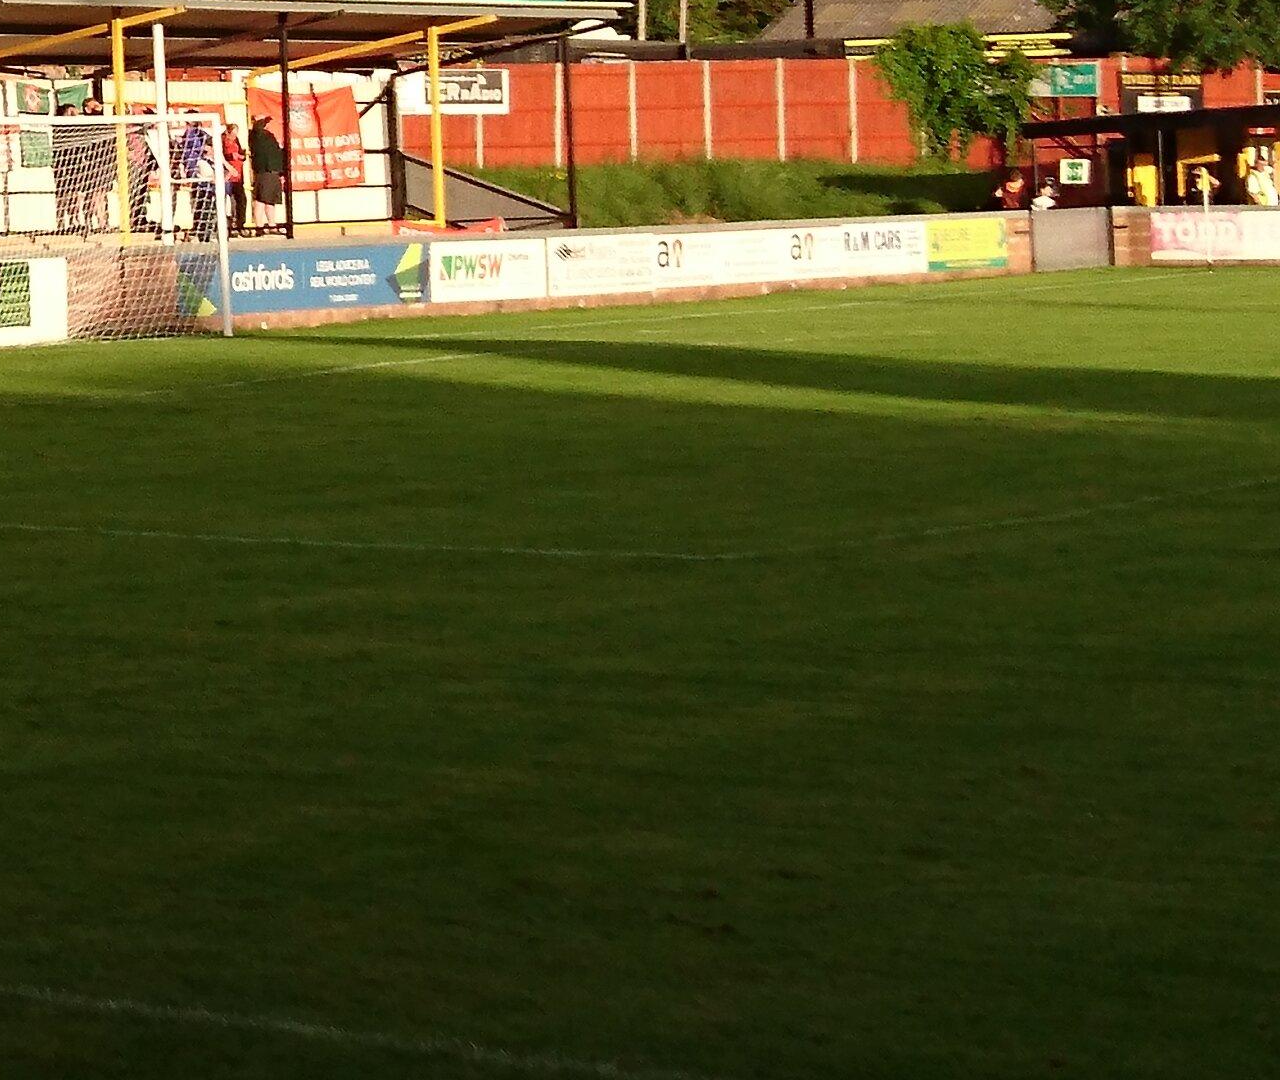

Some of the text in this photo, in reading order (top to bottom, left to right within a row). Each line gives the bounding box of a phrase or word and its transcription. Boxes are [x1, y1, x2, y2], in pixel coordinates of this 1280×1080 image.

[874, 230, 902, 250] CARS
[232, 263, 295, 292] ashfords
[453, 253, 504, 281] PWSW
